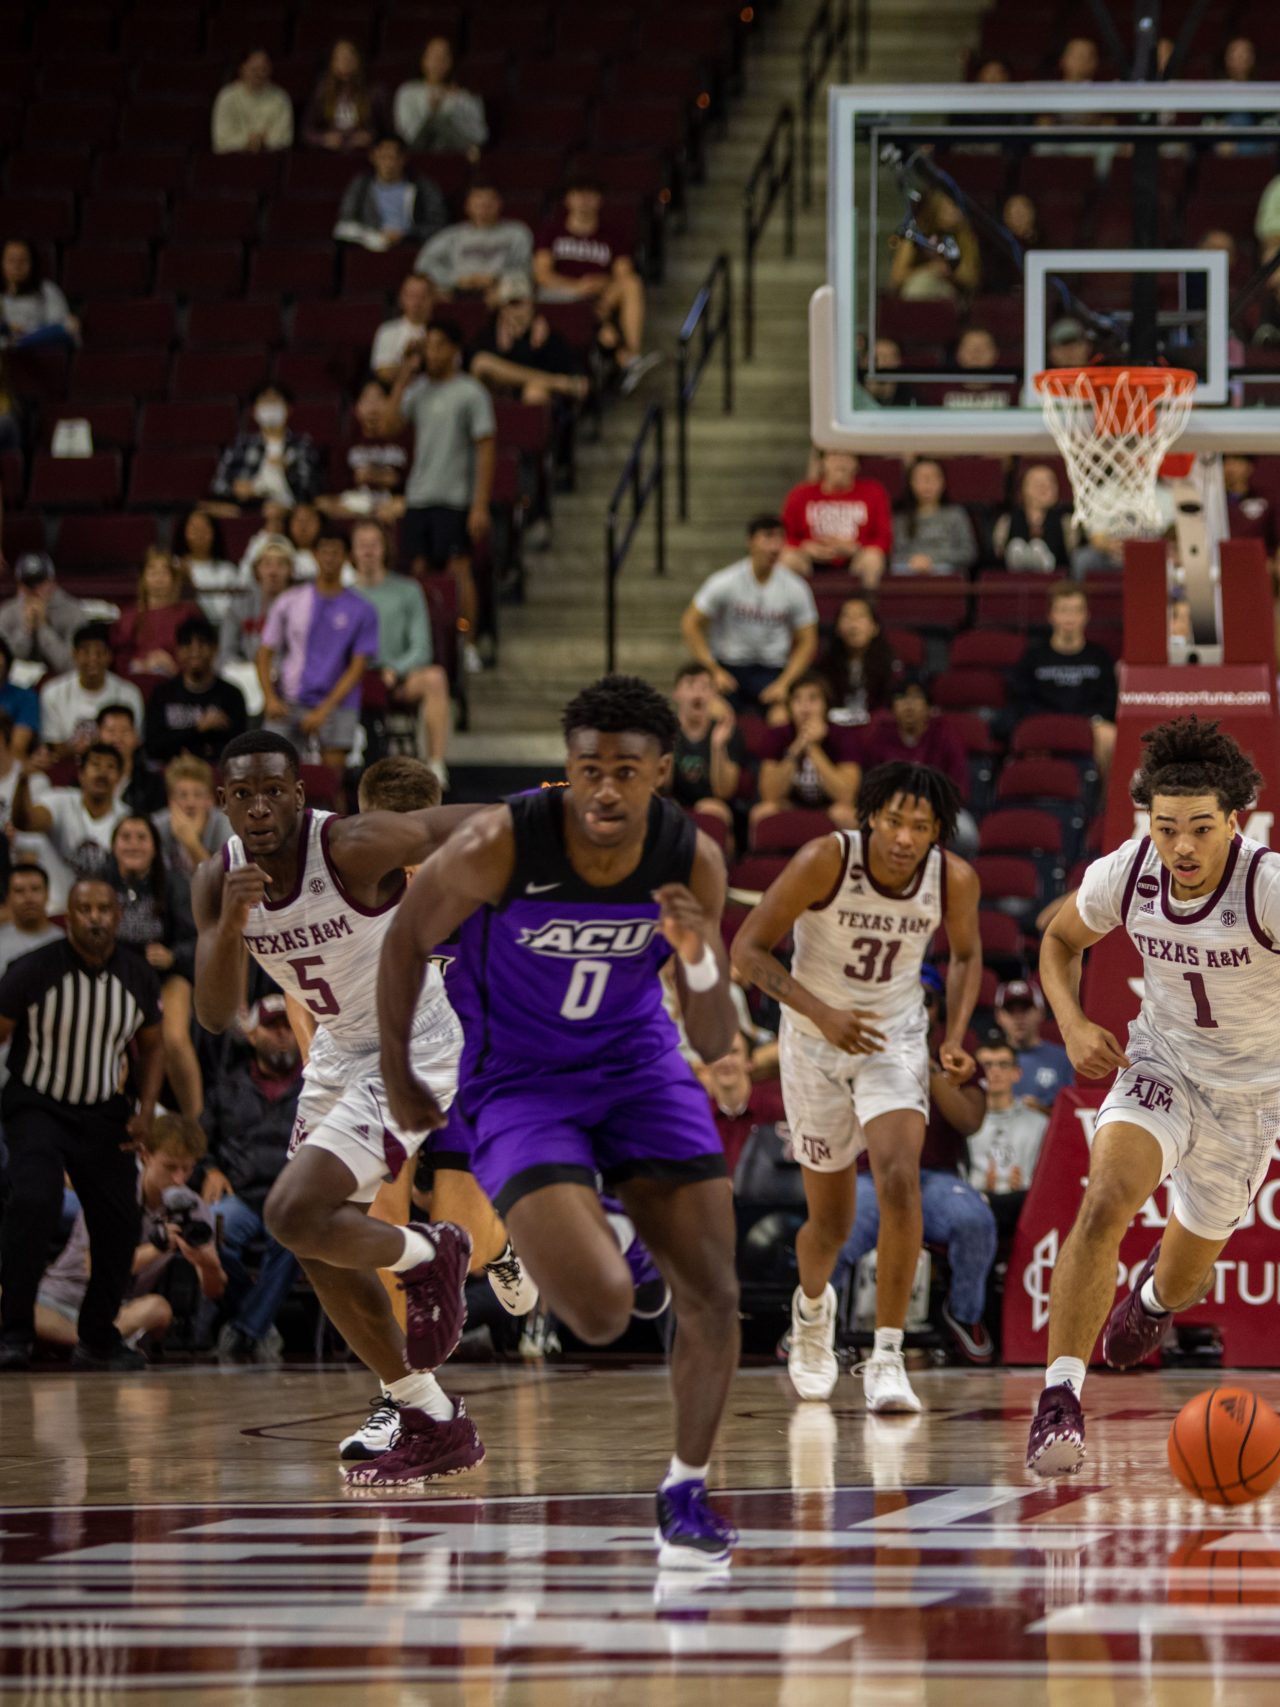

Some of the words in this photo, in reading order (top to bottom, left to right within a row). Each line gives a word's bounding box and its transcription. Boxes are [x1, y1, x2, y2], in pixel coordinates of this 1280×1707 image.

[1119, 690, 1271, 708] www.opportune.com
[243, 927, 309, 955] TEXAS
[308, 914, 354, 945] A&M
[837, 911, 893, 932] TEXAS
[898, 916, 932, 934] A&M
[1222, 911, 1236, 926] SEC
[525, 921, 656, 955] ACU
[1133, 932, 1200, 966] TEXAS
[1206, 946, 1252, 968] A&M
[843, 936, 903, 983] 31
[286, 955, 341, 1016] 5
[560, 959, 613, 1020] 0
[1182, 971, 1219, 1028] 1
